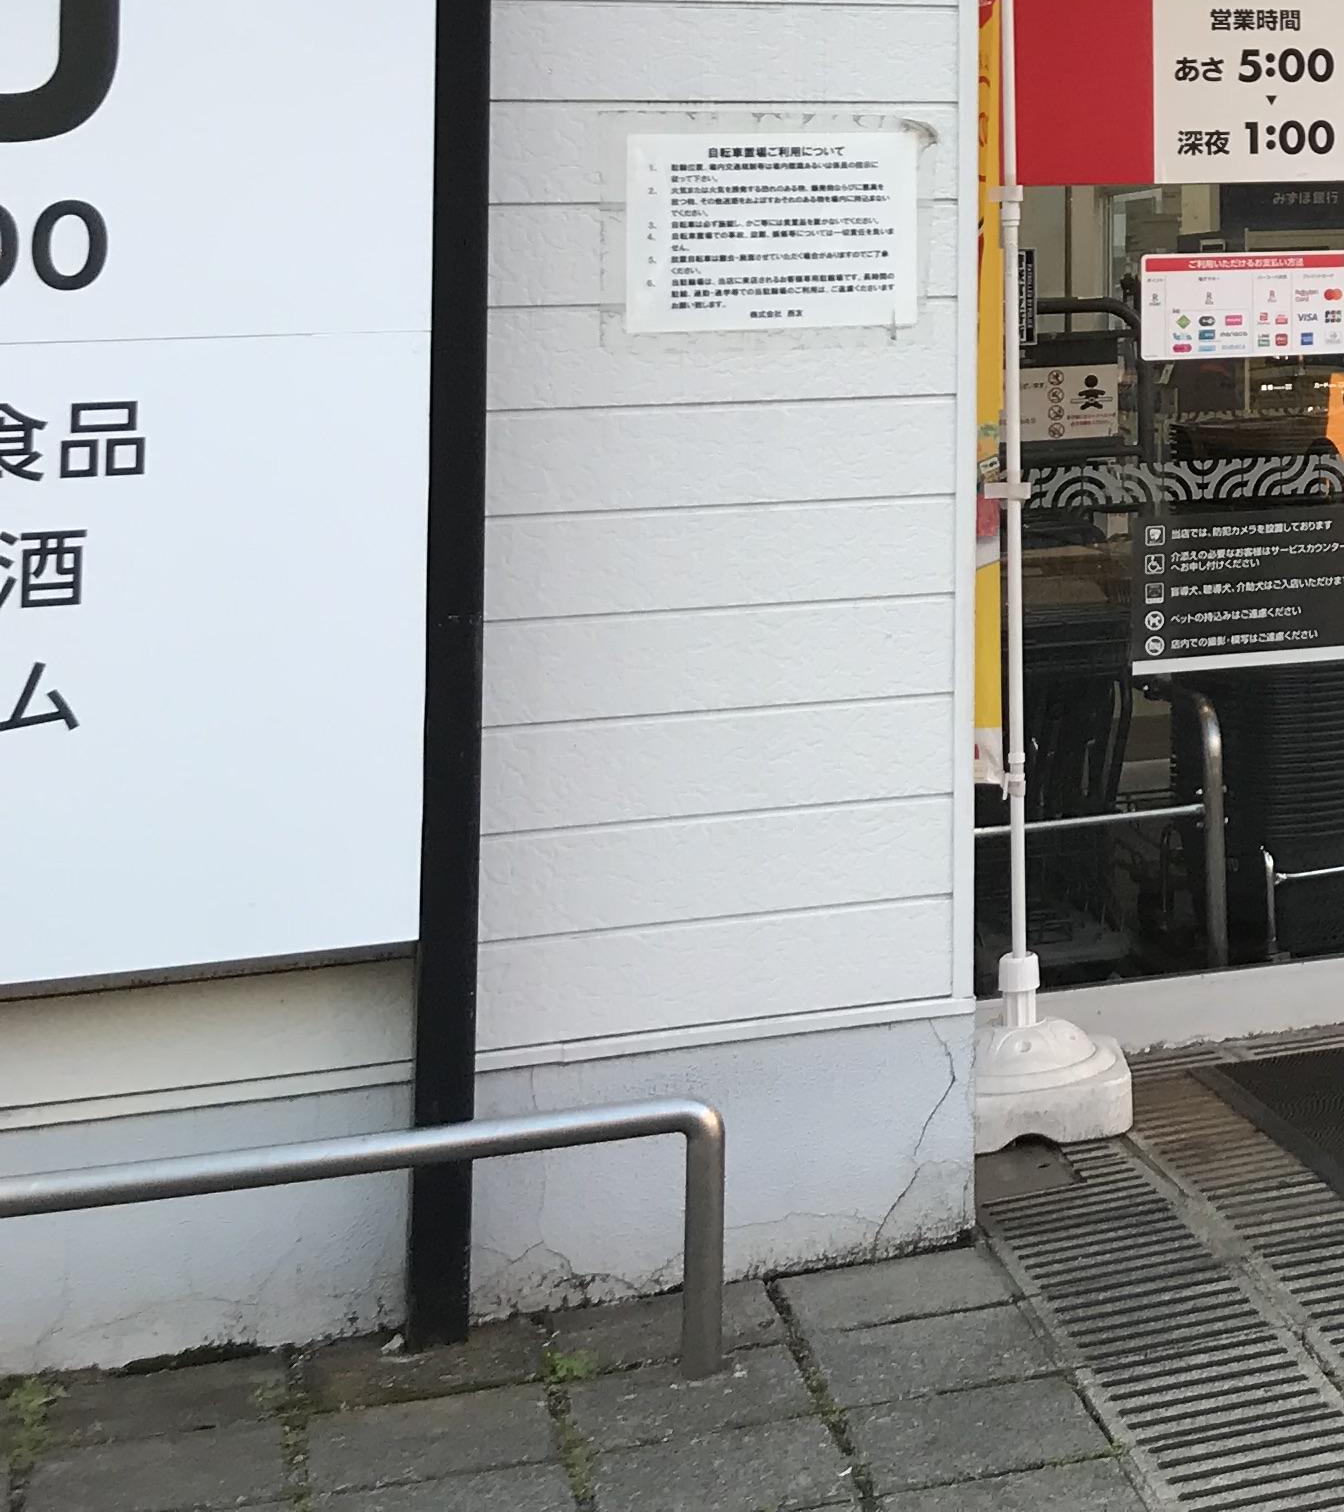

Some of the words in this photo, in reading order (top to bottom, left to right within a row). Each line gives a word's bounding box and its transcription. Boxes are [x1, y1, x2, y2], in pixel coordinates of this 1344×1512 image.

[1210, 8, 1301, 32] 営業時間
[1174, 57, 1225, 83] あさ
[1238, 48, 1335, 84] 5:00
[1177, 130, 1231, 156] 深夜
[1244, 120, 1335, 155] 1:00
[1272, 191, 1339, 206] みずほ銀行
[1297, 313, 1318, 322] VISA
